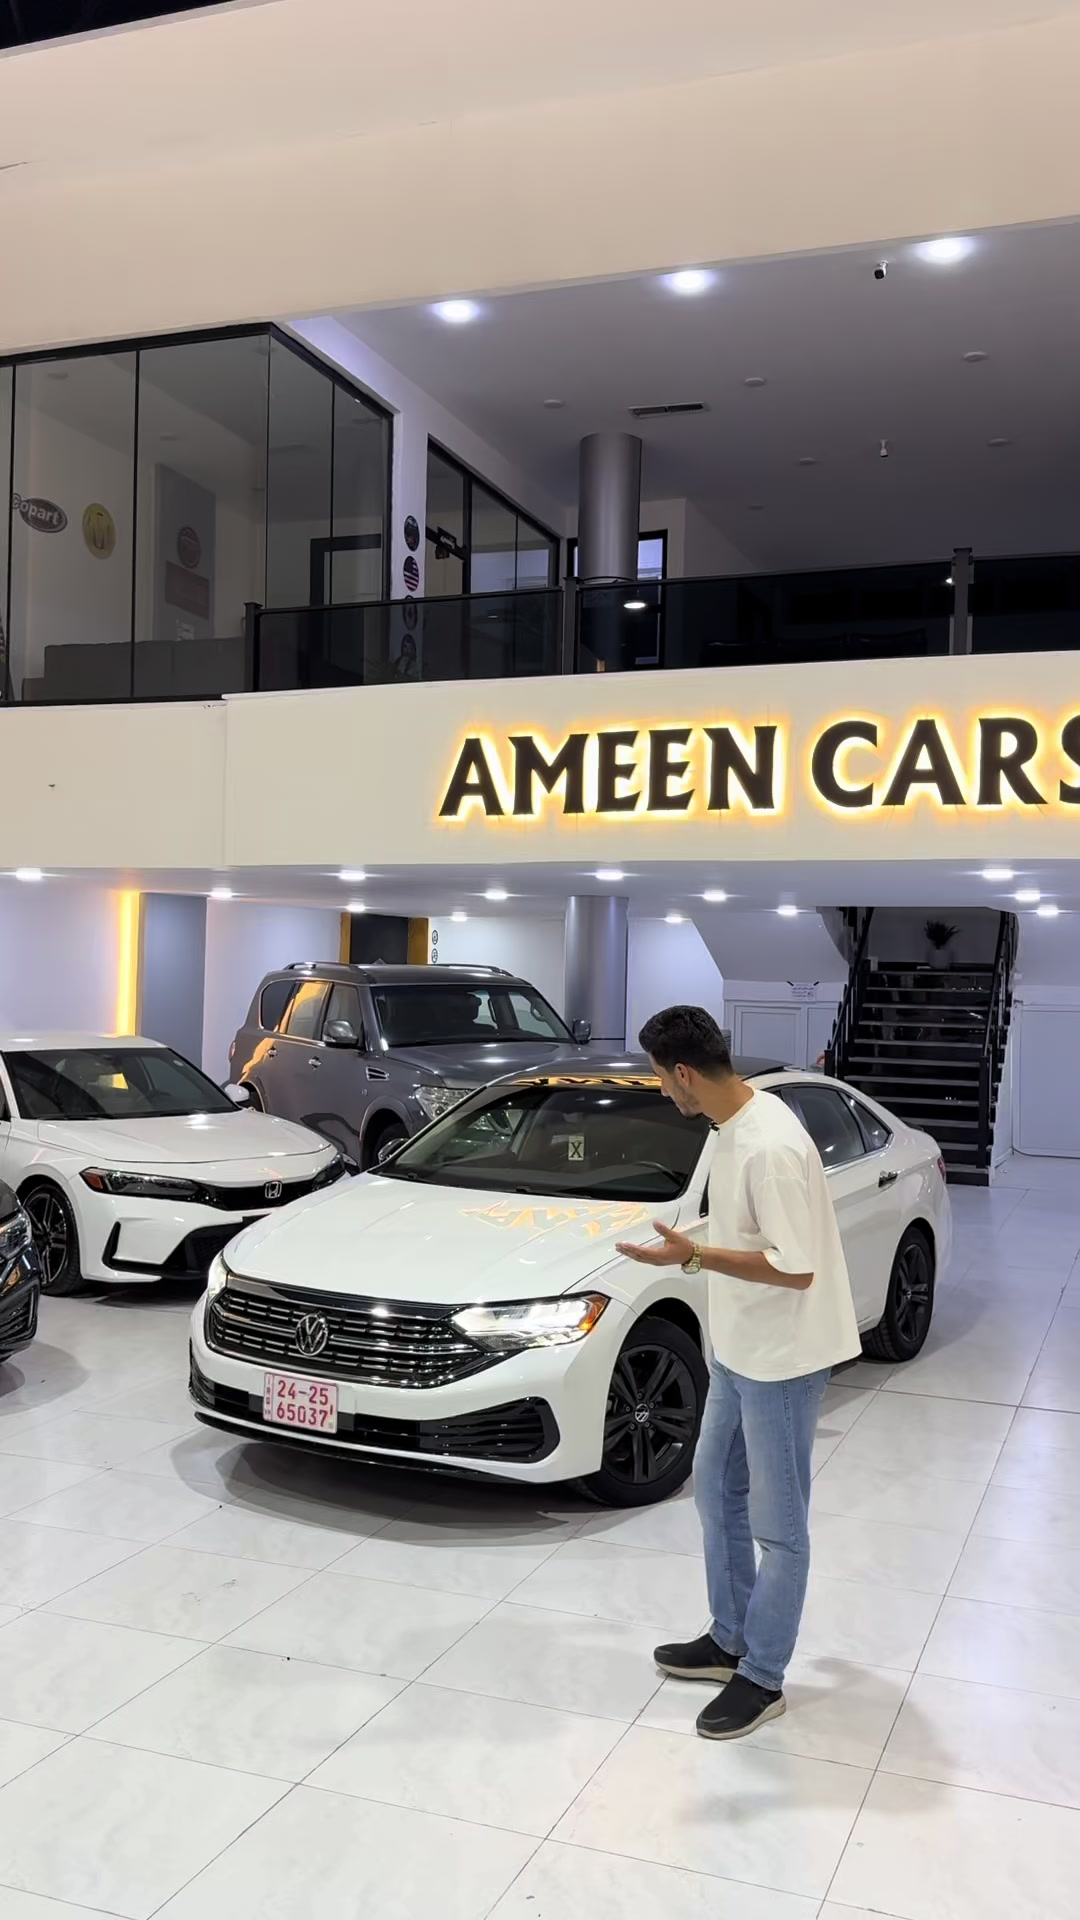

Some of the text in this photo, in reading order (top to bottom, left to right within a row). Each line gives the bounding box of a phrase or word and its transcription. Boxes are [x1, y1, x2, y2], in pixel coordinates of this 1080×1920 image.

[438, 725, 778, 816] AMEEN
[570, 1141, 583, 1159] X
[277, 1379, 329, 1406] 24-25
[276, 1401, 329, 1428] 65037
